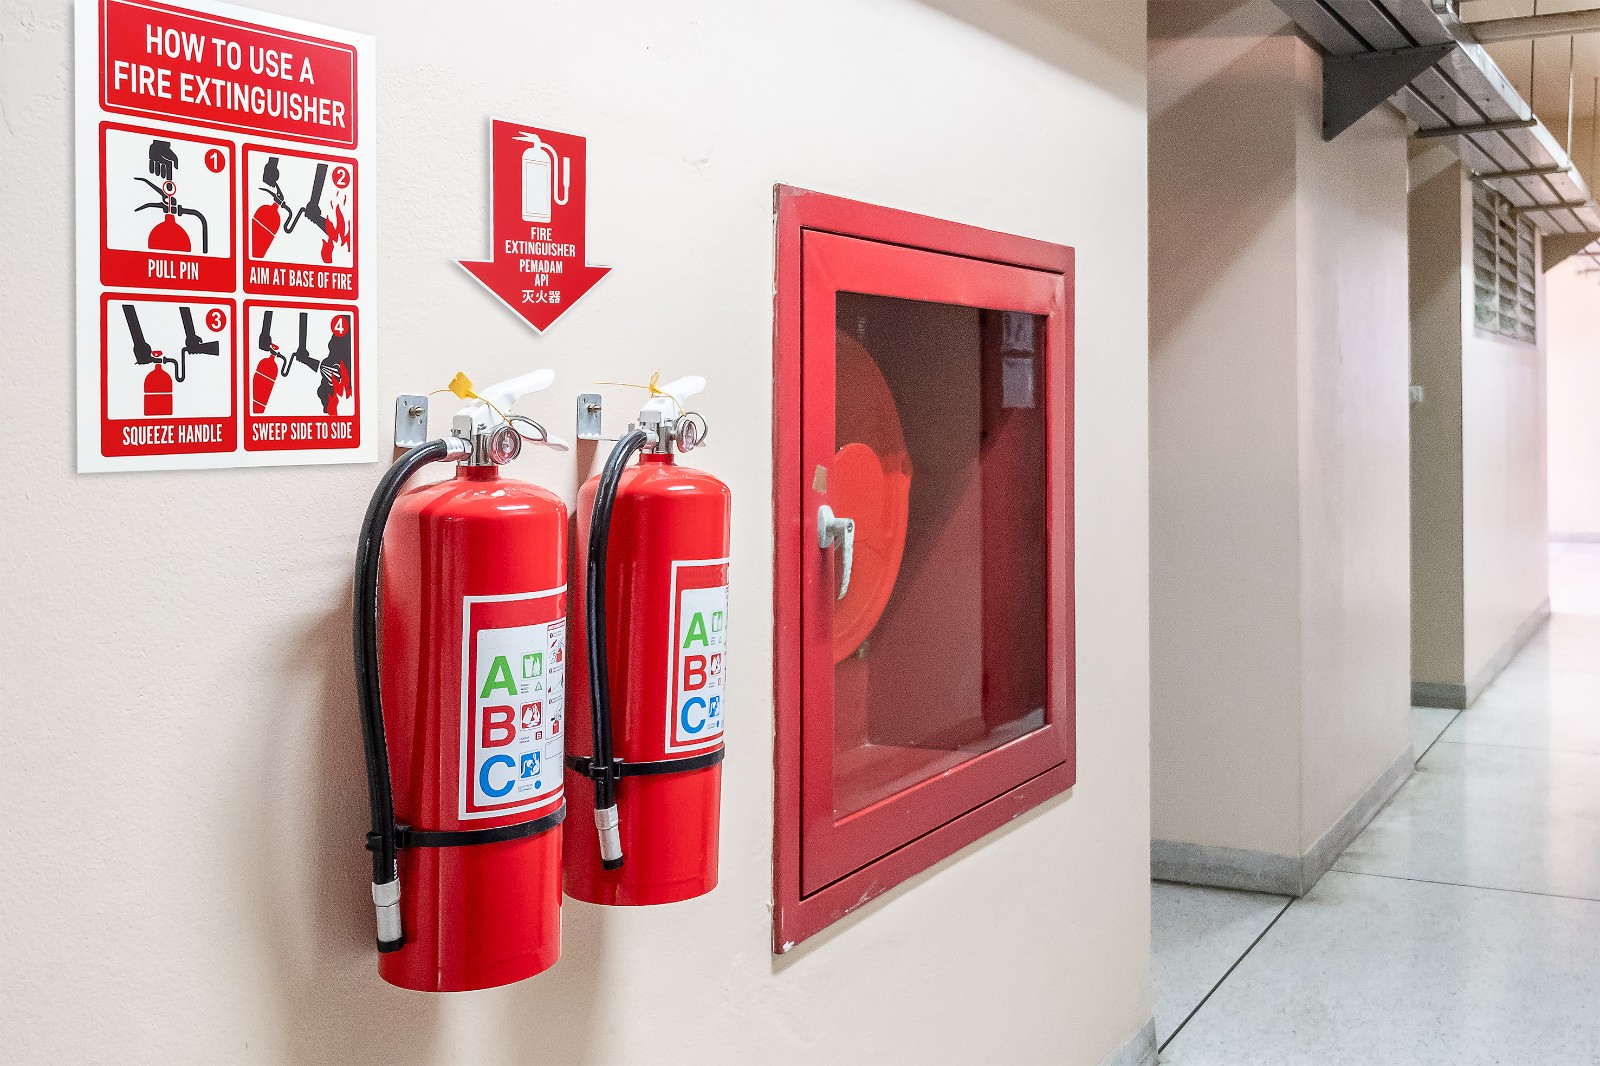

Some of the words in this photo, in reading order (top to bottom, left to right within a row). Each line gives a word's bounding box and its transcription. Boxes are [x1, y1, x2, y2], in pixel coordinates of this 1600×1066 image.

[147, 24, 205, 63] HOW
[212, 38, 242, 71] TO
[249, 46, 293, 81] USE
[299, 57, 315, 85] A
[114, 60, 172, 99] FIRE
[181, 73, 346, 128] EXTINGUISHER
[210, 153, 218, 169] 1
[337, 171, 347, 186] 2
[531, 227, 552, 241] FIRE
[505, 240, 576, 257] EXTINGUISHER
[147, 258, 177, 280] PULL
[179, 261, 199, 281] PIN
[519, 259, 563, 274] PEMADAM
[249, 267, 270, 285] AIM
[272, 269, 287, 286] AT
[289, 271, 315, 288] BASE
[317, 273, 331, 289] OF
[332, 274, 353, 290] FIRE
[534, 274, 549, 286] API
[522, 290, 561, 304] 灭火器
[211, 312, 222, 328] 3
[334, 318, 344, 334] 4
[122, 424, 174, 446] SQUEEZE
[178, 423, 223, 443] HANDLE
[252, 423, 288, 441] SWEEP
[290, 423, 313, 440] SIDE
[315, 423, 330, 440] TO
[331, 422, 353, 439] SIDE
[682, 612, 709, 648] A
[479, 655, 518, 698] A
[683, 655, 707, 691] B
[482, 705, 516, 748] B
[681, 697, 706, 734] C
[479, 754, 516, 798] C
